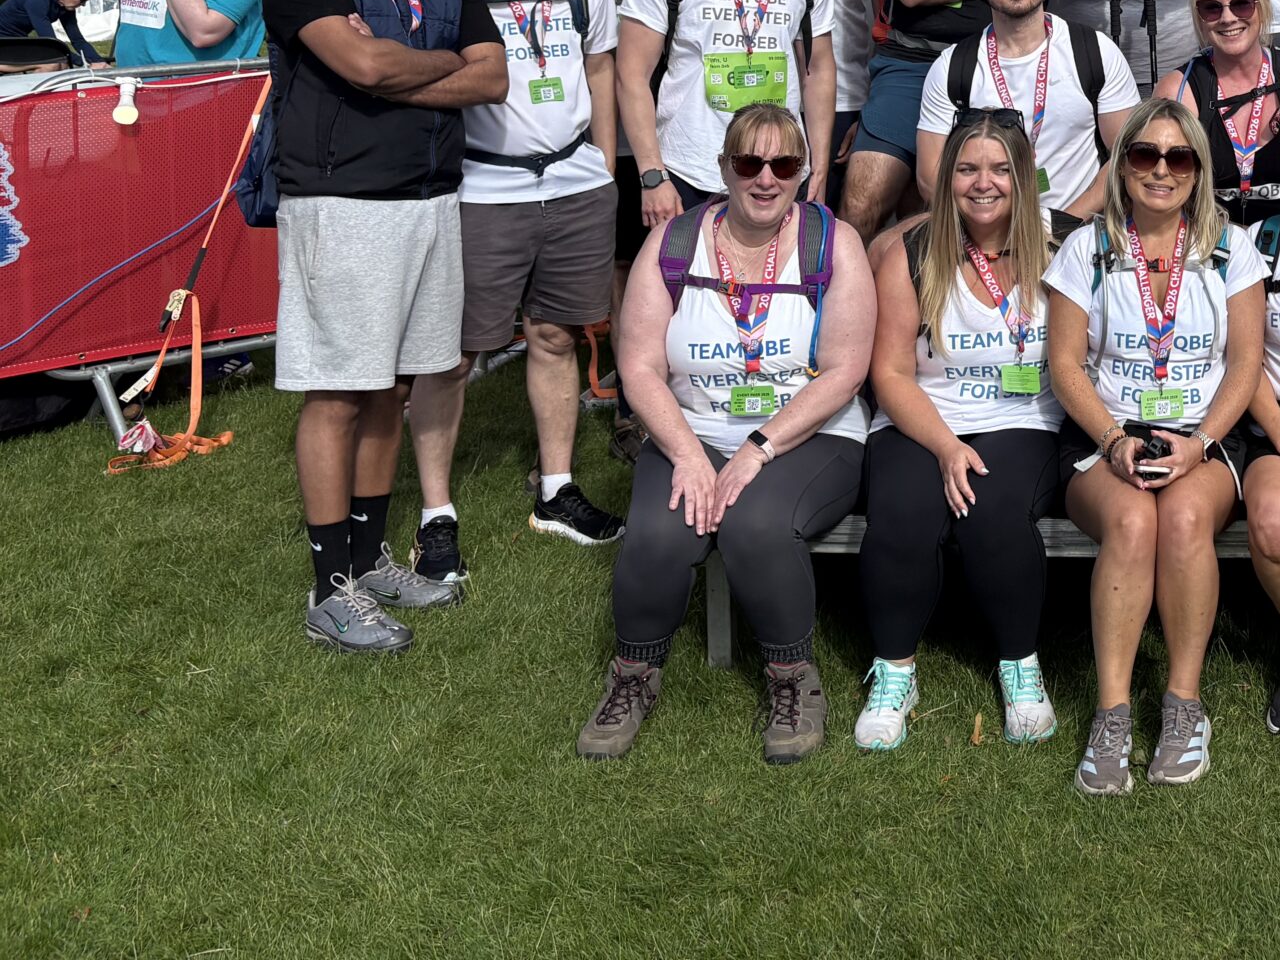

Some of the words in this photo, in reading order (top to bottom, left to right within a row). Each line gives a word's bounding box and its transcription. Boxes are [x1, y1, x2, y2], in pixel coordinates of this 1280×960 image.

[543, 43, 570, 58] SEB
[988, 36, 996, 59] 2026
[1035, 82, 1045, 107] 2026
[1248, 118, 1260, 141] 2026
[984, 272, 1003, 299] 2026
[1128, 230, 1140, 255] 2026
[1135, 254, 1157, 321] CHALLENGER
[1164, 288, 1178, 317] 2026
[688, 342, 745, 360] TEAM
[948, 331, 1003, 350] TEAM
[1114, 333, 1150, 349] TEA
[1173, 332, 1213, 353] QBE
[944, 364, 1003, 380] EVERY
[1112, 359, 1155, 381] EVER
[1171, 363, 1212, 381] STEP
[960, 383, 999, 400] FOR
